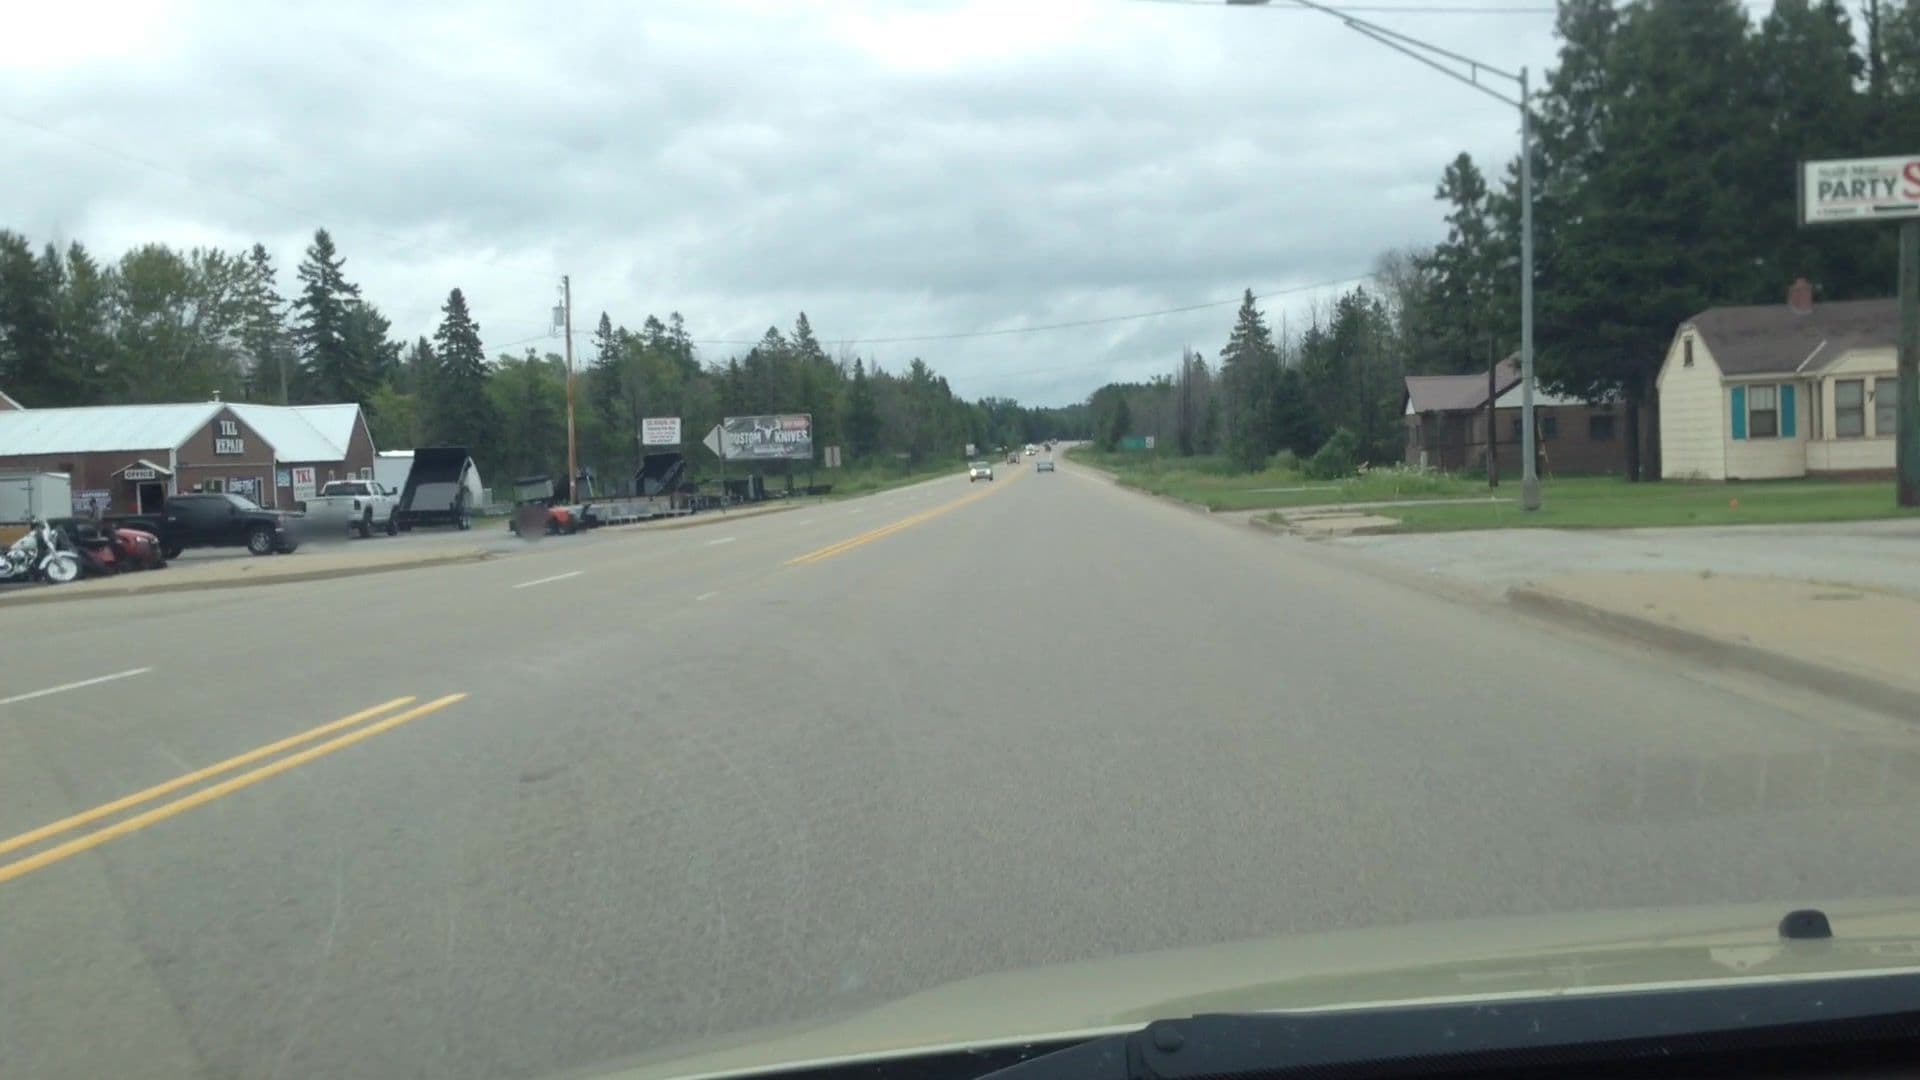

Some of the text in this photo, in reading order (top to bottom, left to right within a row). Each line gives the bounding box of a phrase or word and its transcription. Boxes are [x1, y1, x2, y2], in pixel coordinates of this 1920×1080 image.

[1818, 177, 1897, 200] PARTY
[775, 430, 808, 443] KNIVES
[216, 439, 244, 454] REPAIR
